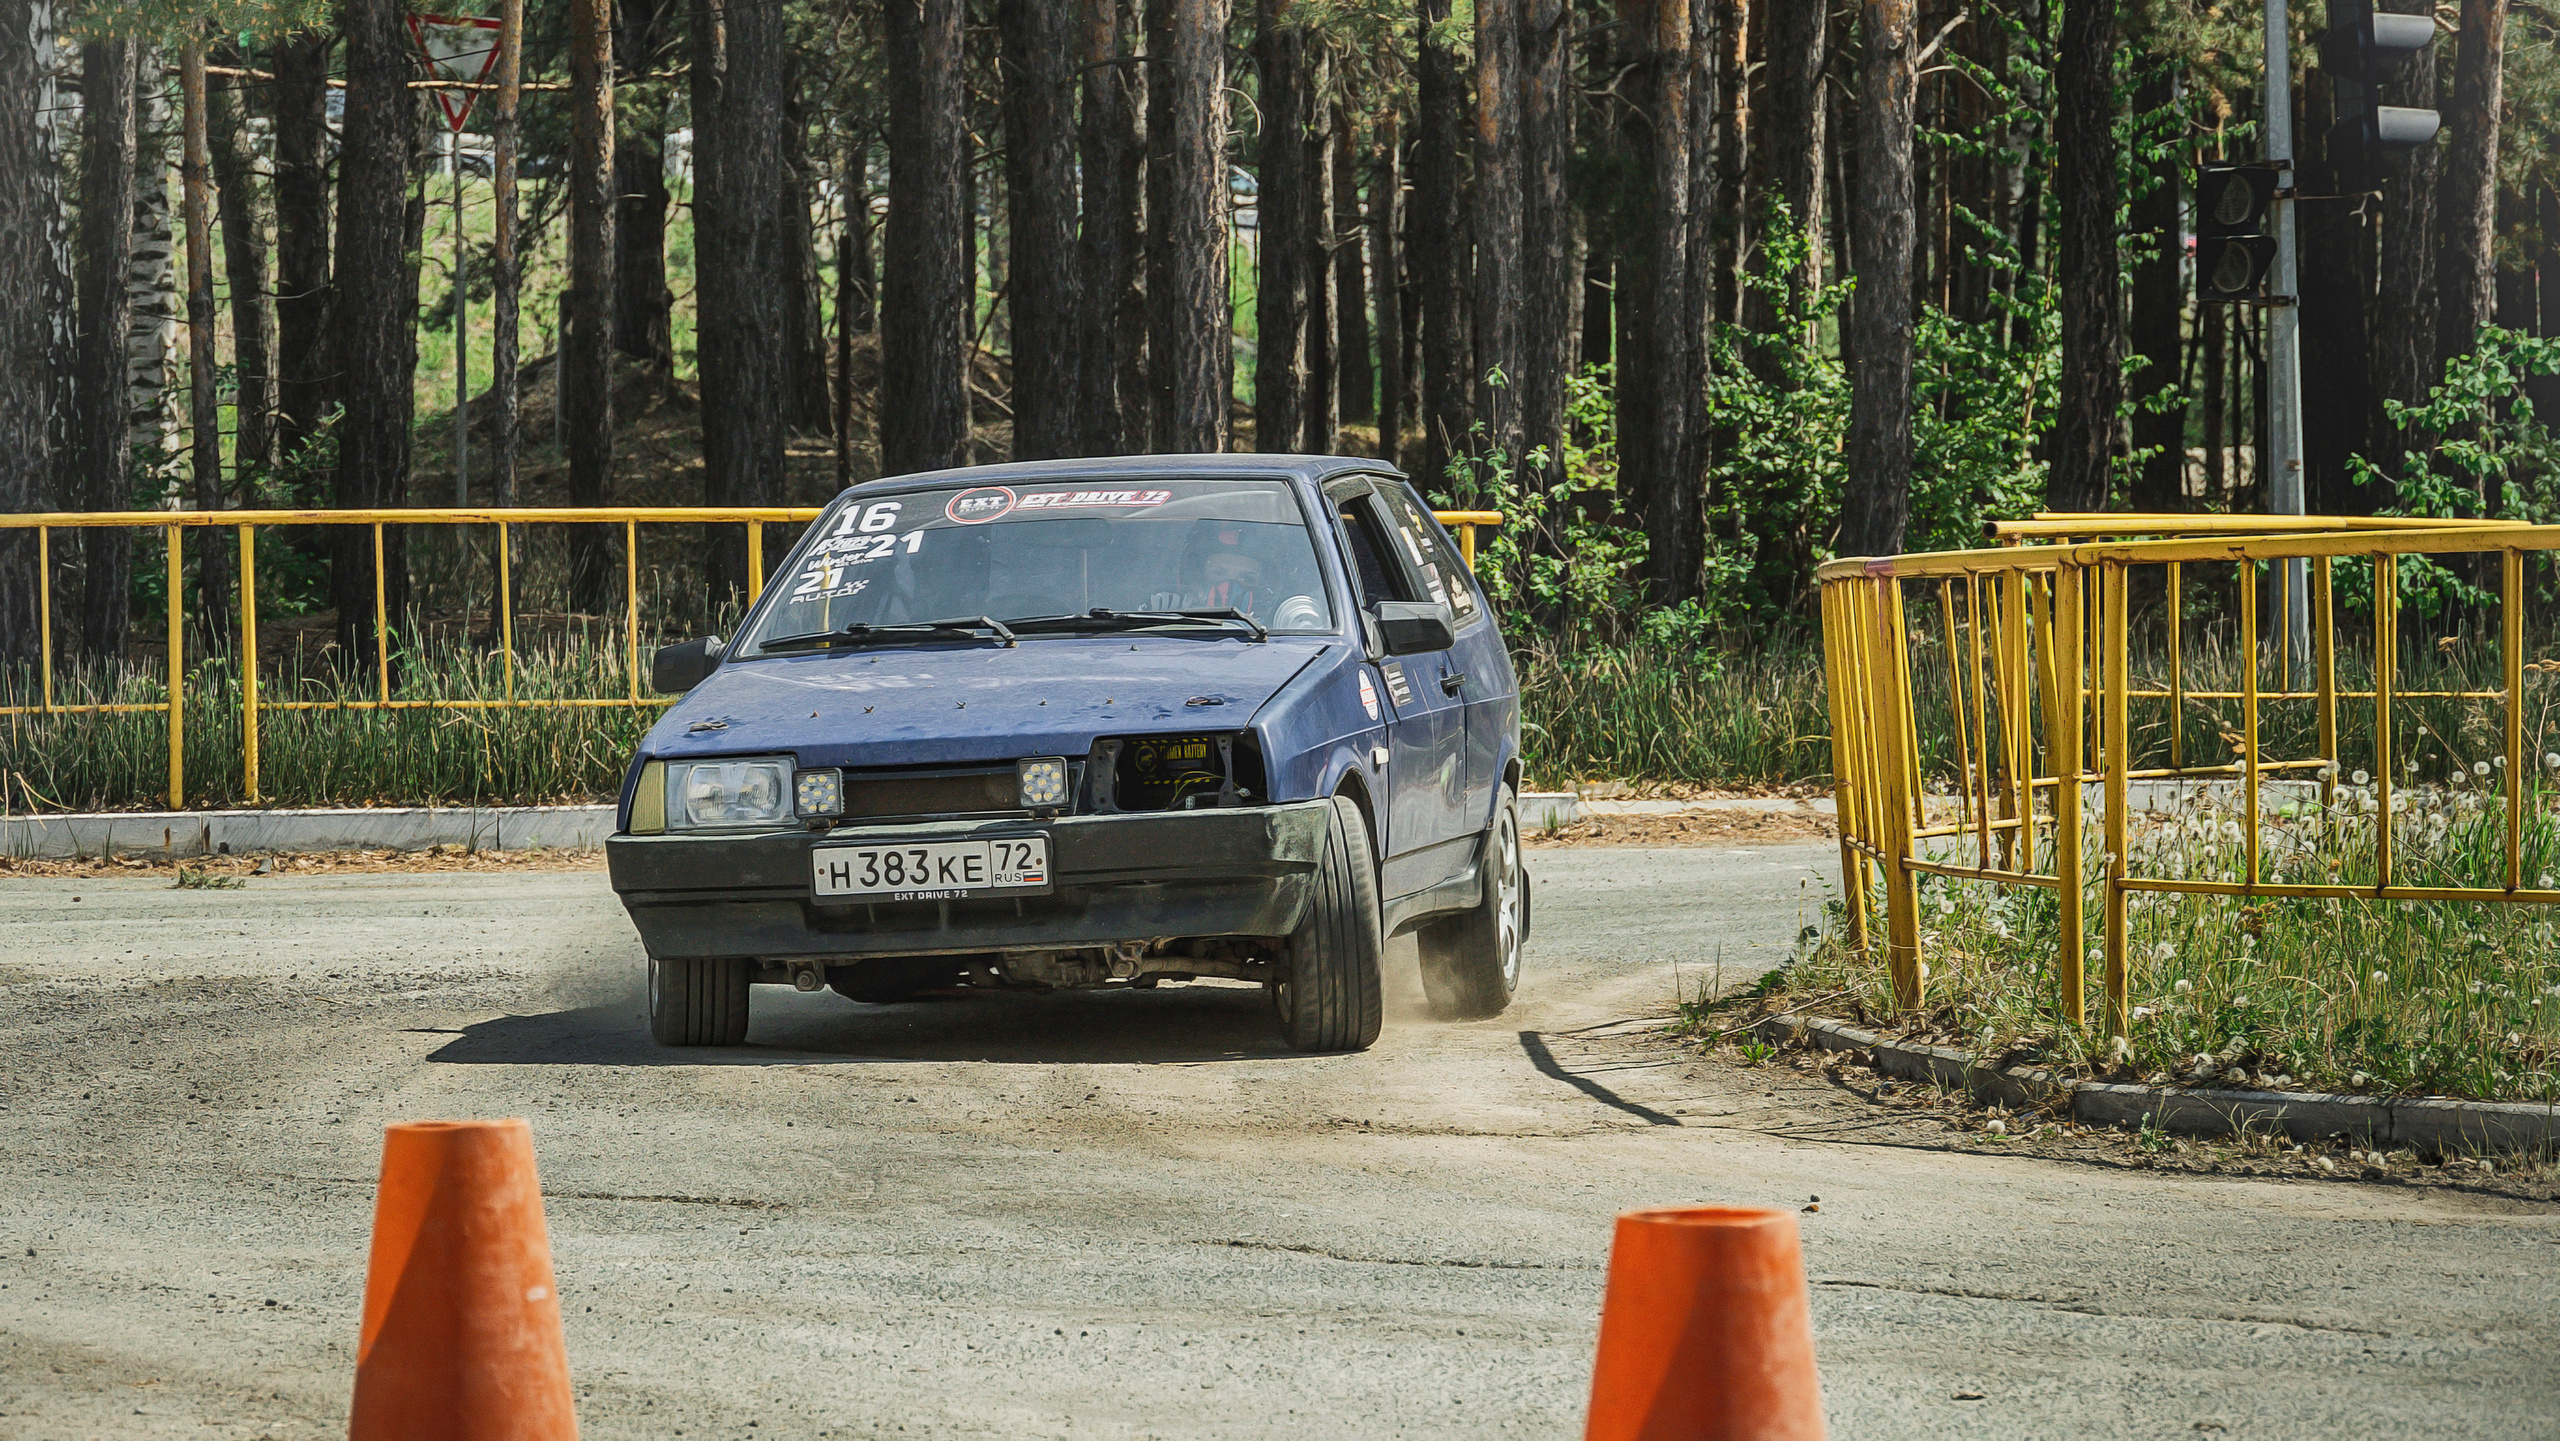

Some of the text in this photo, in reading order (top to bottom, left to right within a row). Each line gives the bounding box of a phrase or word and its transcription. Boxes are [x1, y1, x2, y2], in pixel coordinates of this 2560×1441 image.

[959, 496, 1004, 508] EXT
[1025, 493, 1069, 505] EXT
[1070, 490, 1138, 502] DRIVE
[1145, 490, 1171, 501] 72
[832, 501, 902, 536] 16
[865, 530, 925, 559] 21
[793, 568, 844, 595] 21
[995, 842, 1033, 871] 72
[995, 872, 1022, 883] RUS
[894, 889, 969, 901] EXT DRIVE 72
